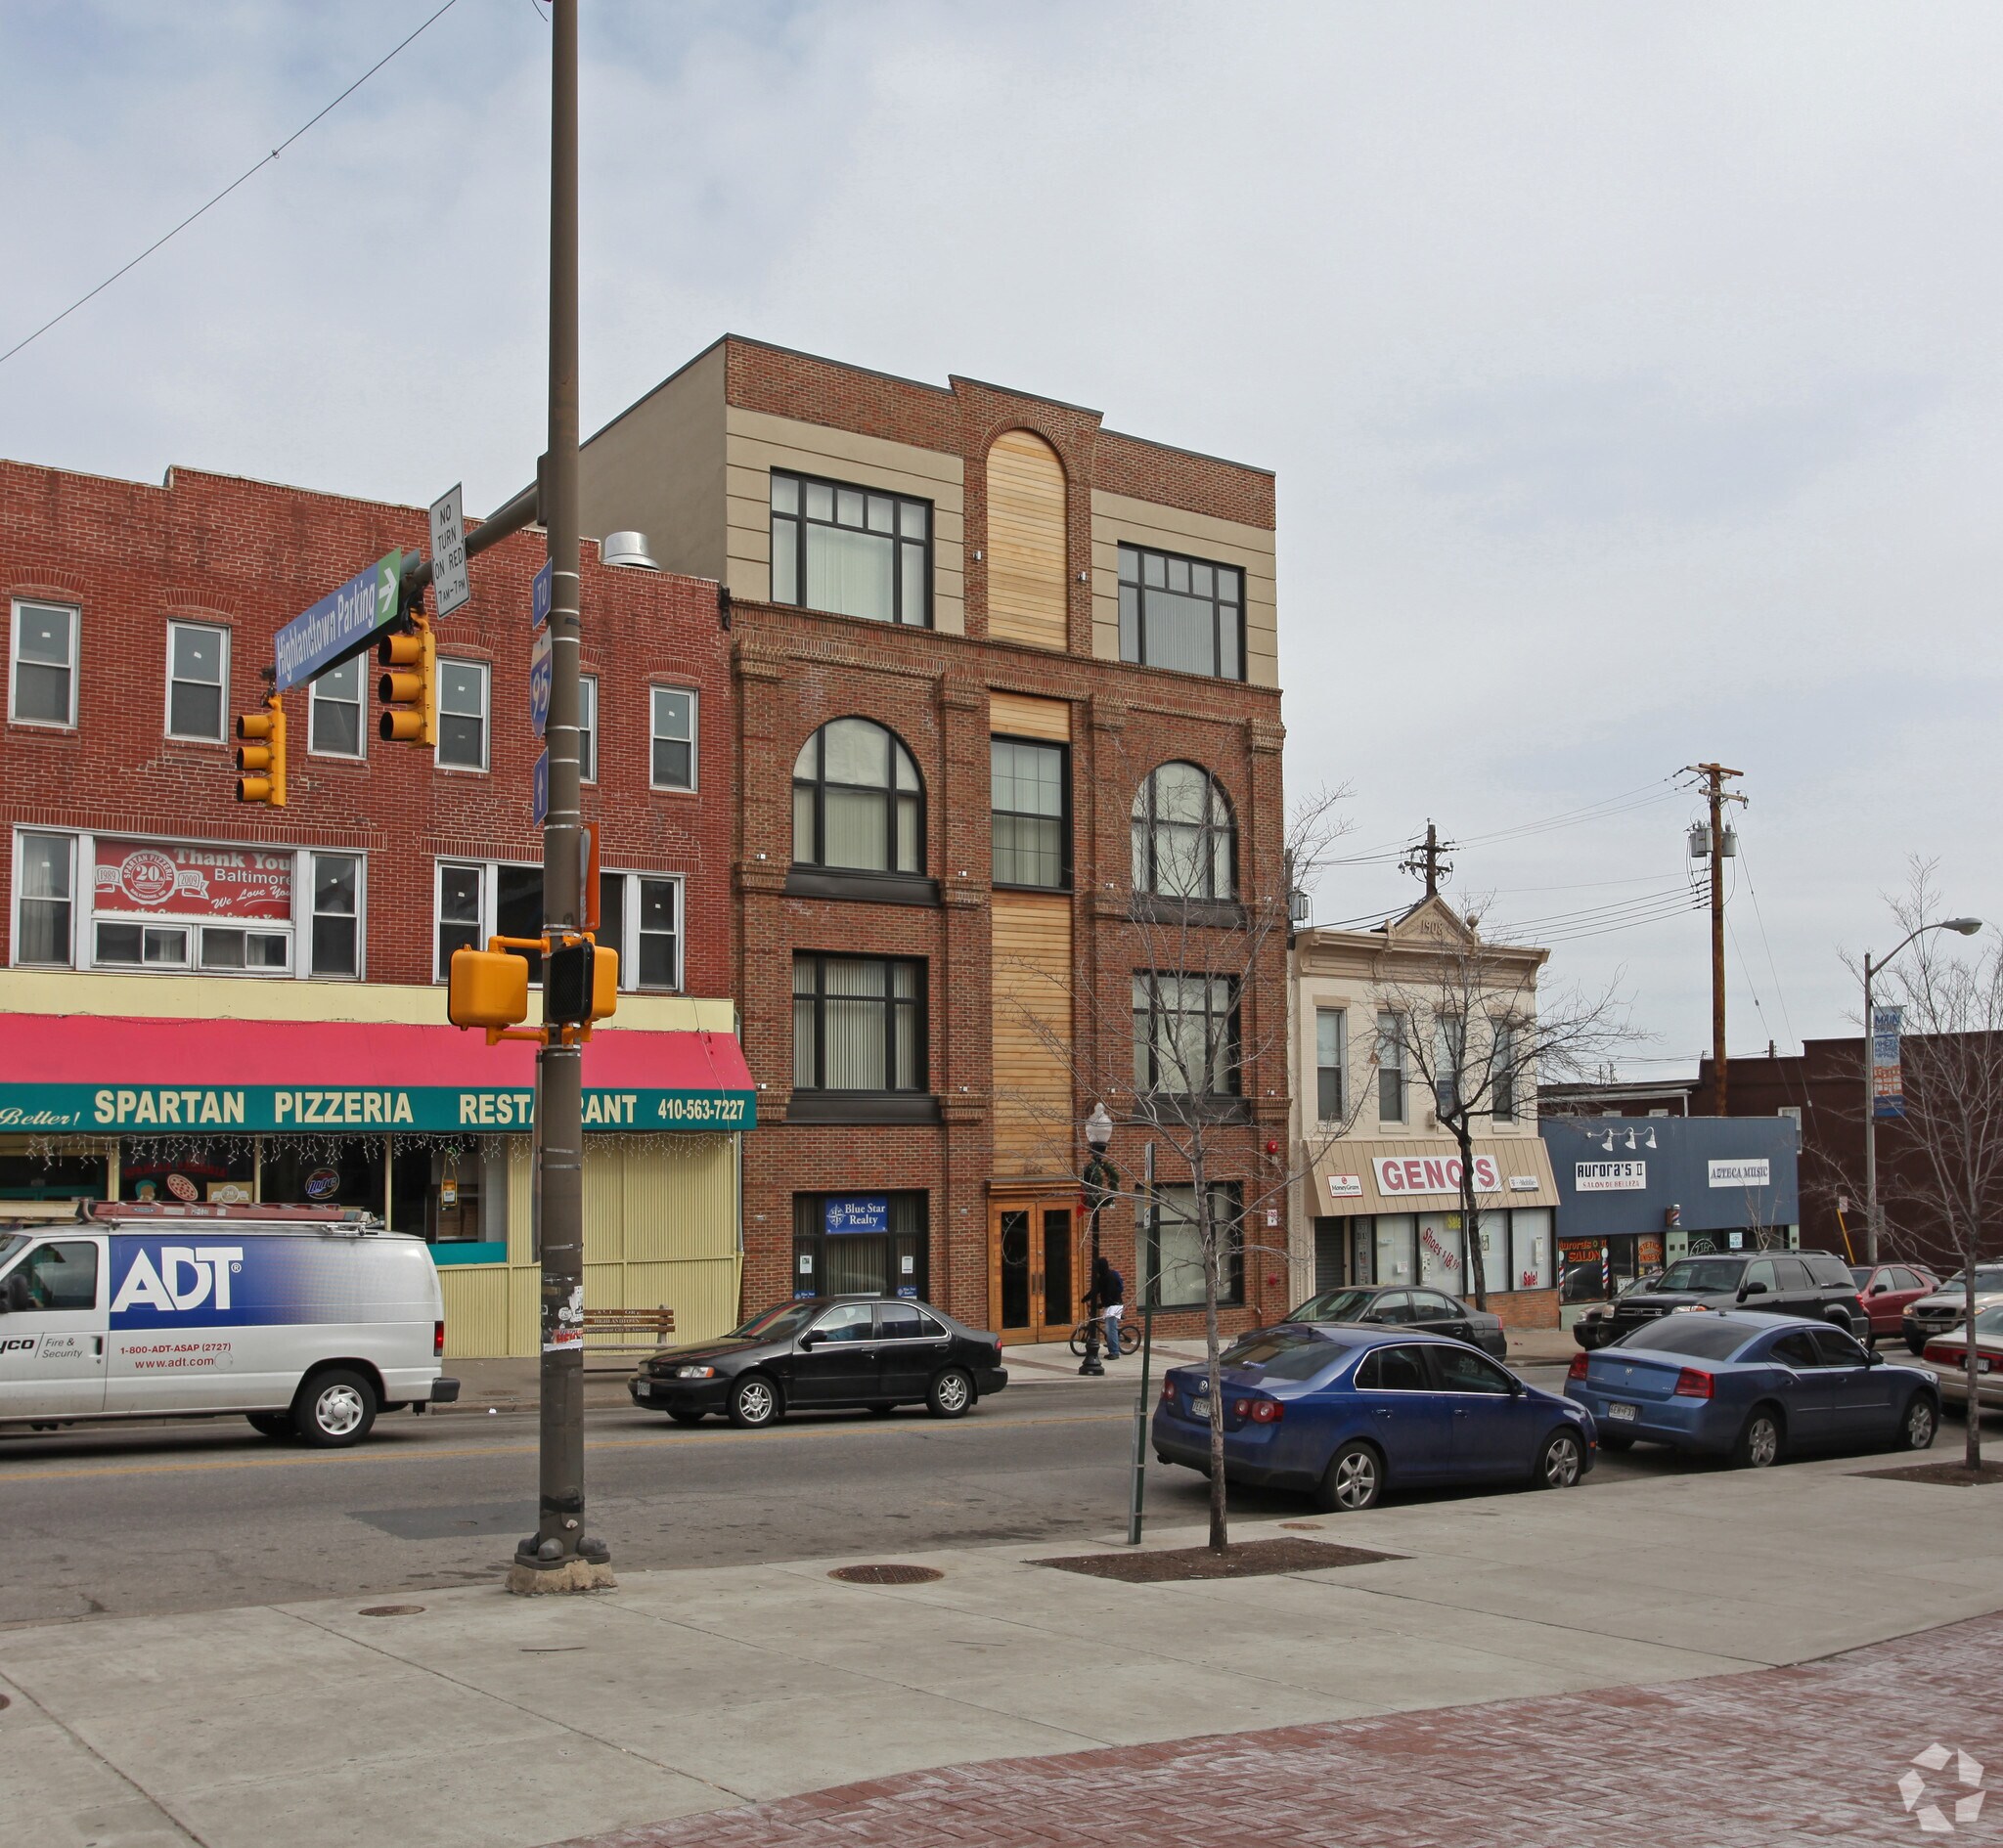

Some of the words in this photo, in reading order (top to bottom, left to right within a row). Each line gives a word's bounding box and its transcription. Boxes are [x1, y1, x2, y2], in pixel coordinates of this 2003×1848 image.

[440, 504, 451, 526] NO
[438, 525, 457, 552] TURN
[434, 558, 445, 580] ON
[449, 547, 464, 570] RED
[537, 577, 547, 613] TO
[277, 614, 336, 682] Highlandtown
[337, 580, 376, 638] Parking
[532, 662, 549, 716] 95
[123, 855, 148, 879] SPARTAN
[150, 854, 173, 881] PIZZERIA
[174, 848, 245, 867] Thank
[251, 852, 291, 871] You
[100, 869, 116, 881] 1989
[180, 873, 198, 886] 2009
[211, 897, 232, 908] We
[237, 889, 266, 902] Love
[0, 1107, 81, 1126] Better!
[94, 1090, 245, 1123] SPARTAN
[275, 1092, 414, 1123] PIZZERIA
[460, 1093, 637, 1124] RESTANT
[658, 1098, 745, 1121] 410-563-7227
[1382, 1159, 1495, 1191] GENOS
[1711, 1166, 1743, 1179] AZTECA
[1743, 1166, 1768, 1178] MUSIC
[845, 1204, 866, 1213] Blue
[868, 1203, 885, 1212] Star
[849, 1214, 878, 1226] Realty
[1422, 1227, 1443, 1256] Shoes
[1568, 1251, 1600, 1262] SALON
[110, 1247, 244, 1312] ADT
[42, 1348, 83, 1359] Security
[46, 1339, 65, 1347] Fire
[67, 1338, 75, 1346] &
[120, 1344, 200, 1355] 1-800-ADT-ASAP
[201, 1342, 232, 1353] (2727)
[135, 1356, 214, 1369] www.adt.com
